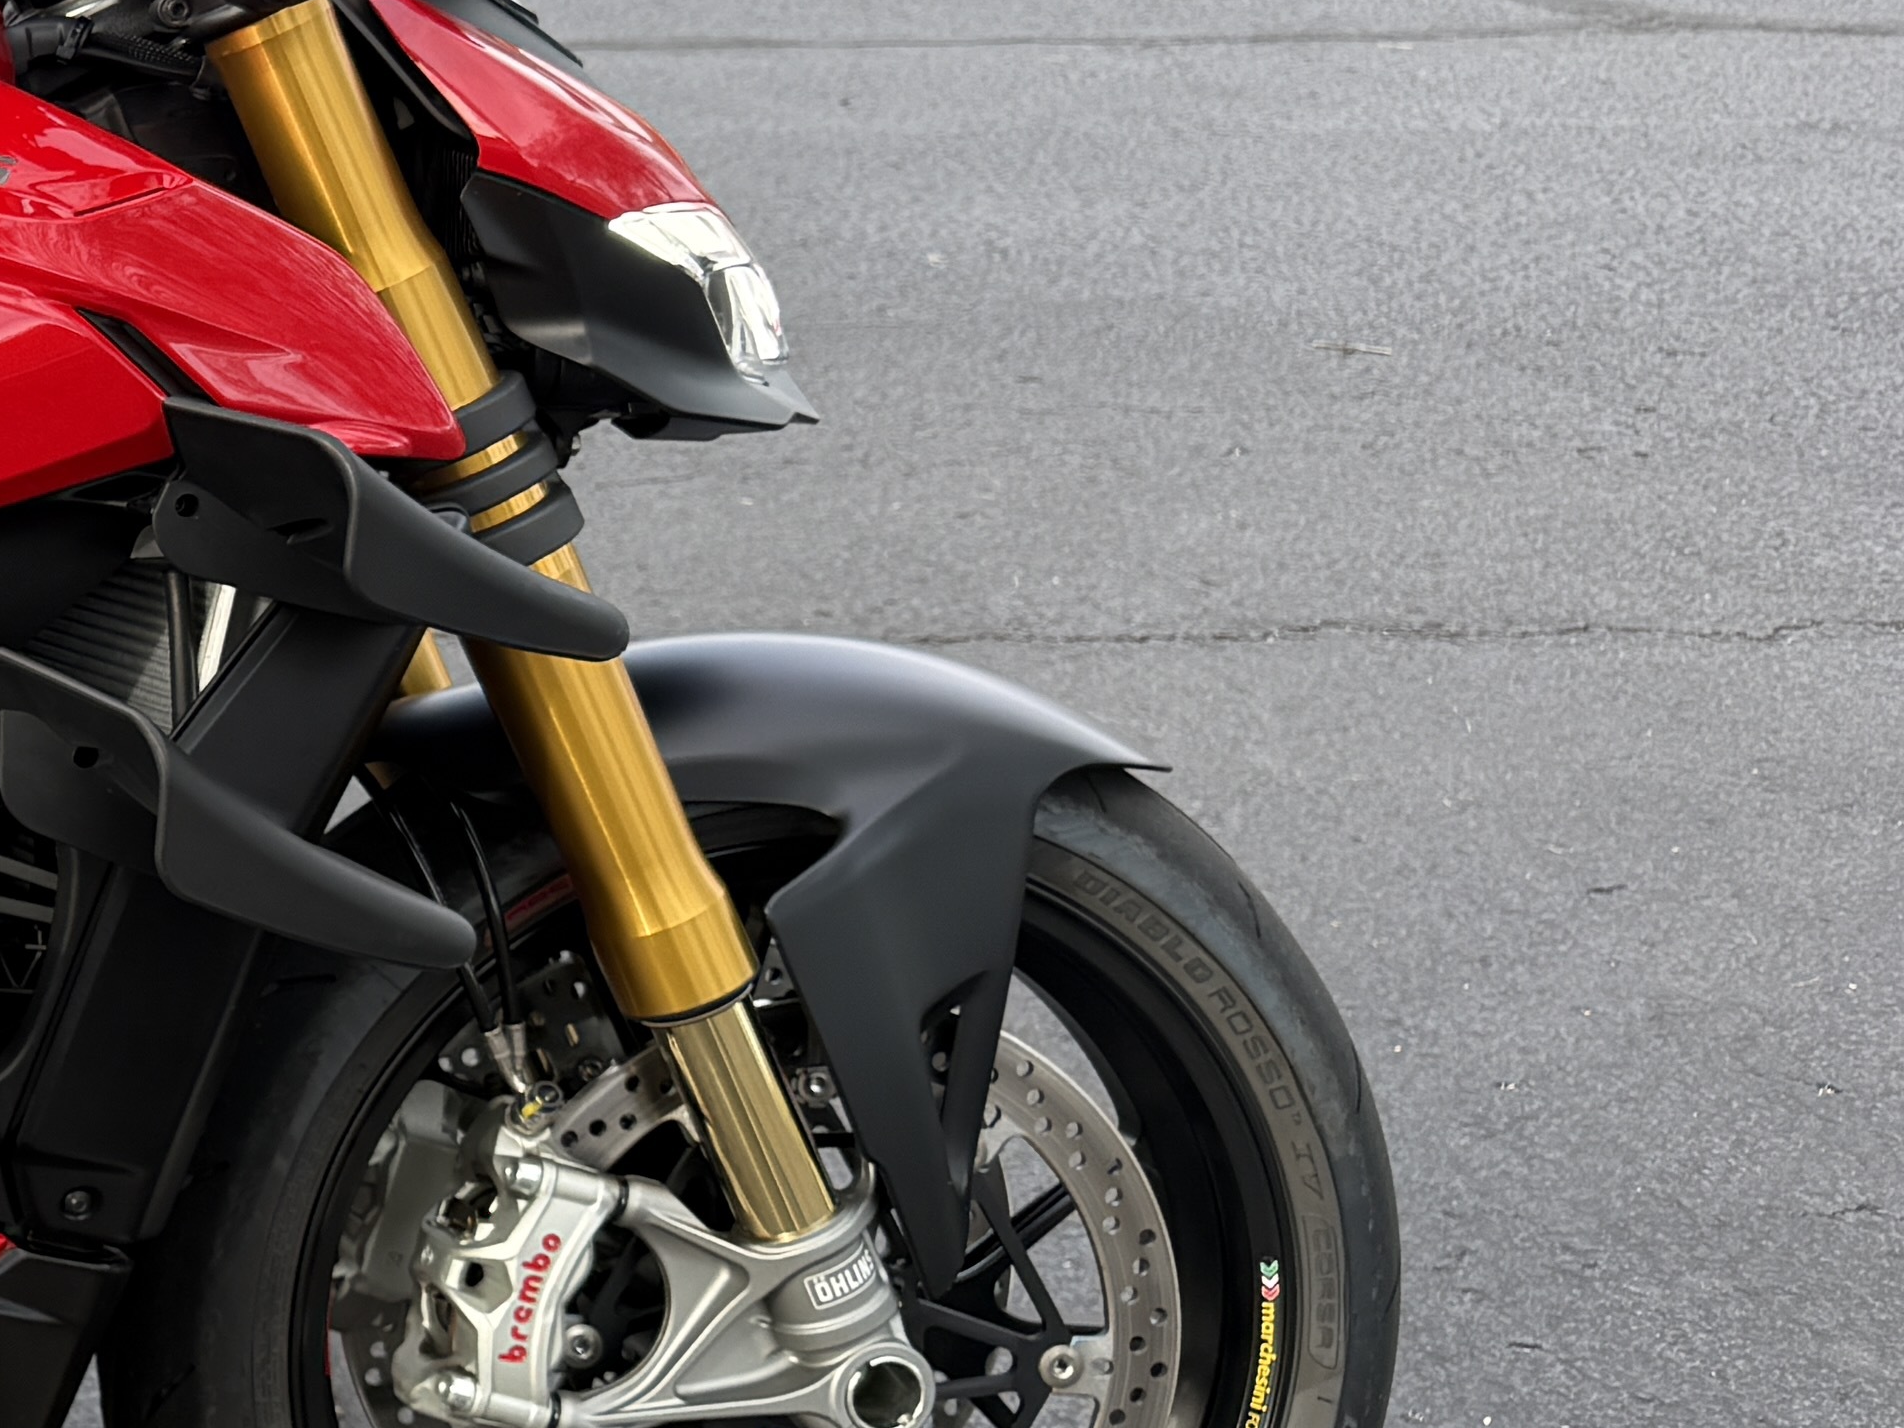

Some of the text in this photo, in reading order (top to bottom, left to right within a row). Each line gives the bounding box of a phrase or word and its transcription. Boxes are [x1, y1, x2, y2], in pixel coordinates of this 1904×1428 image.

[1072, 871, 1215, 985] DIABLO
[1206, 983, 1297, 1111] ROSSO
[498, 1232, 562, 1364] brembo
[1249, 1301, 1278, 1414] marchesini
